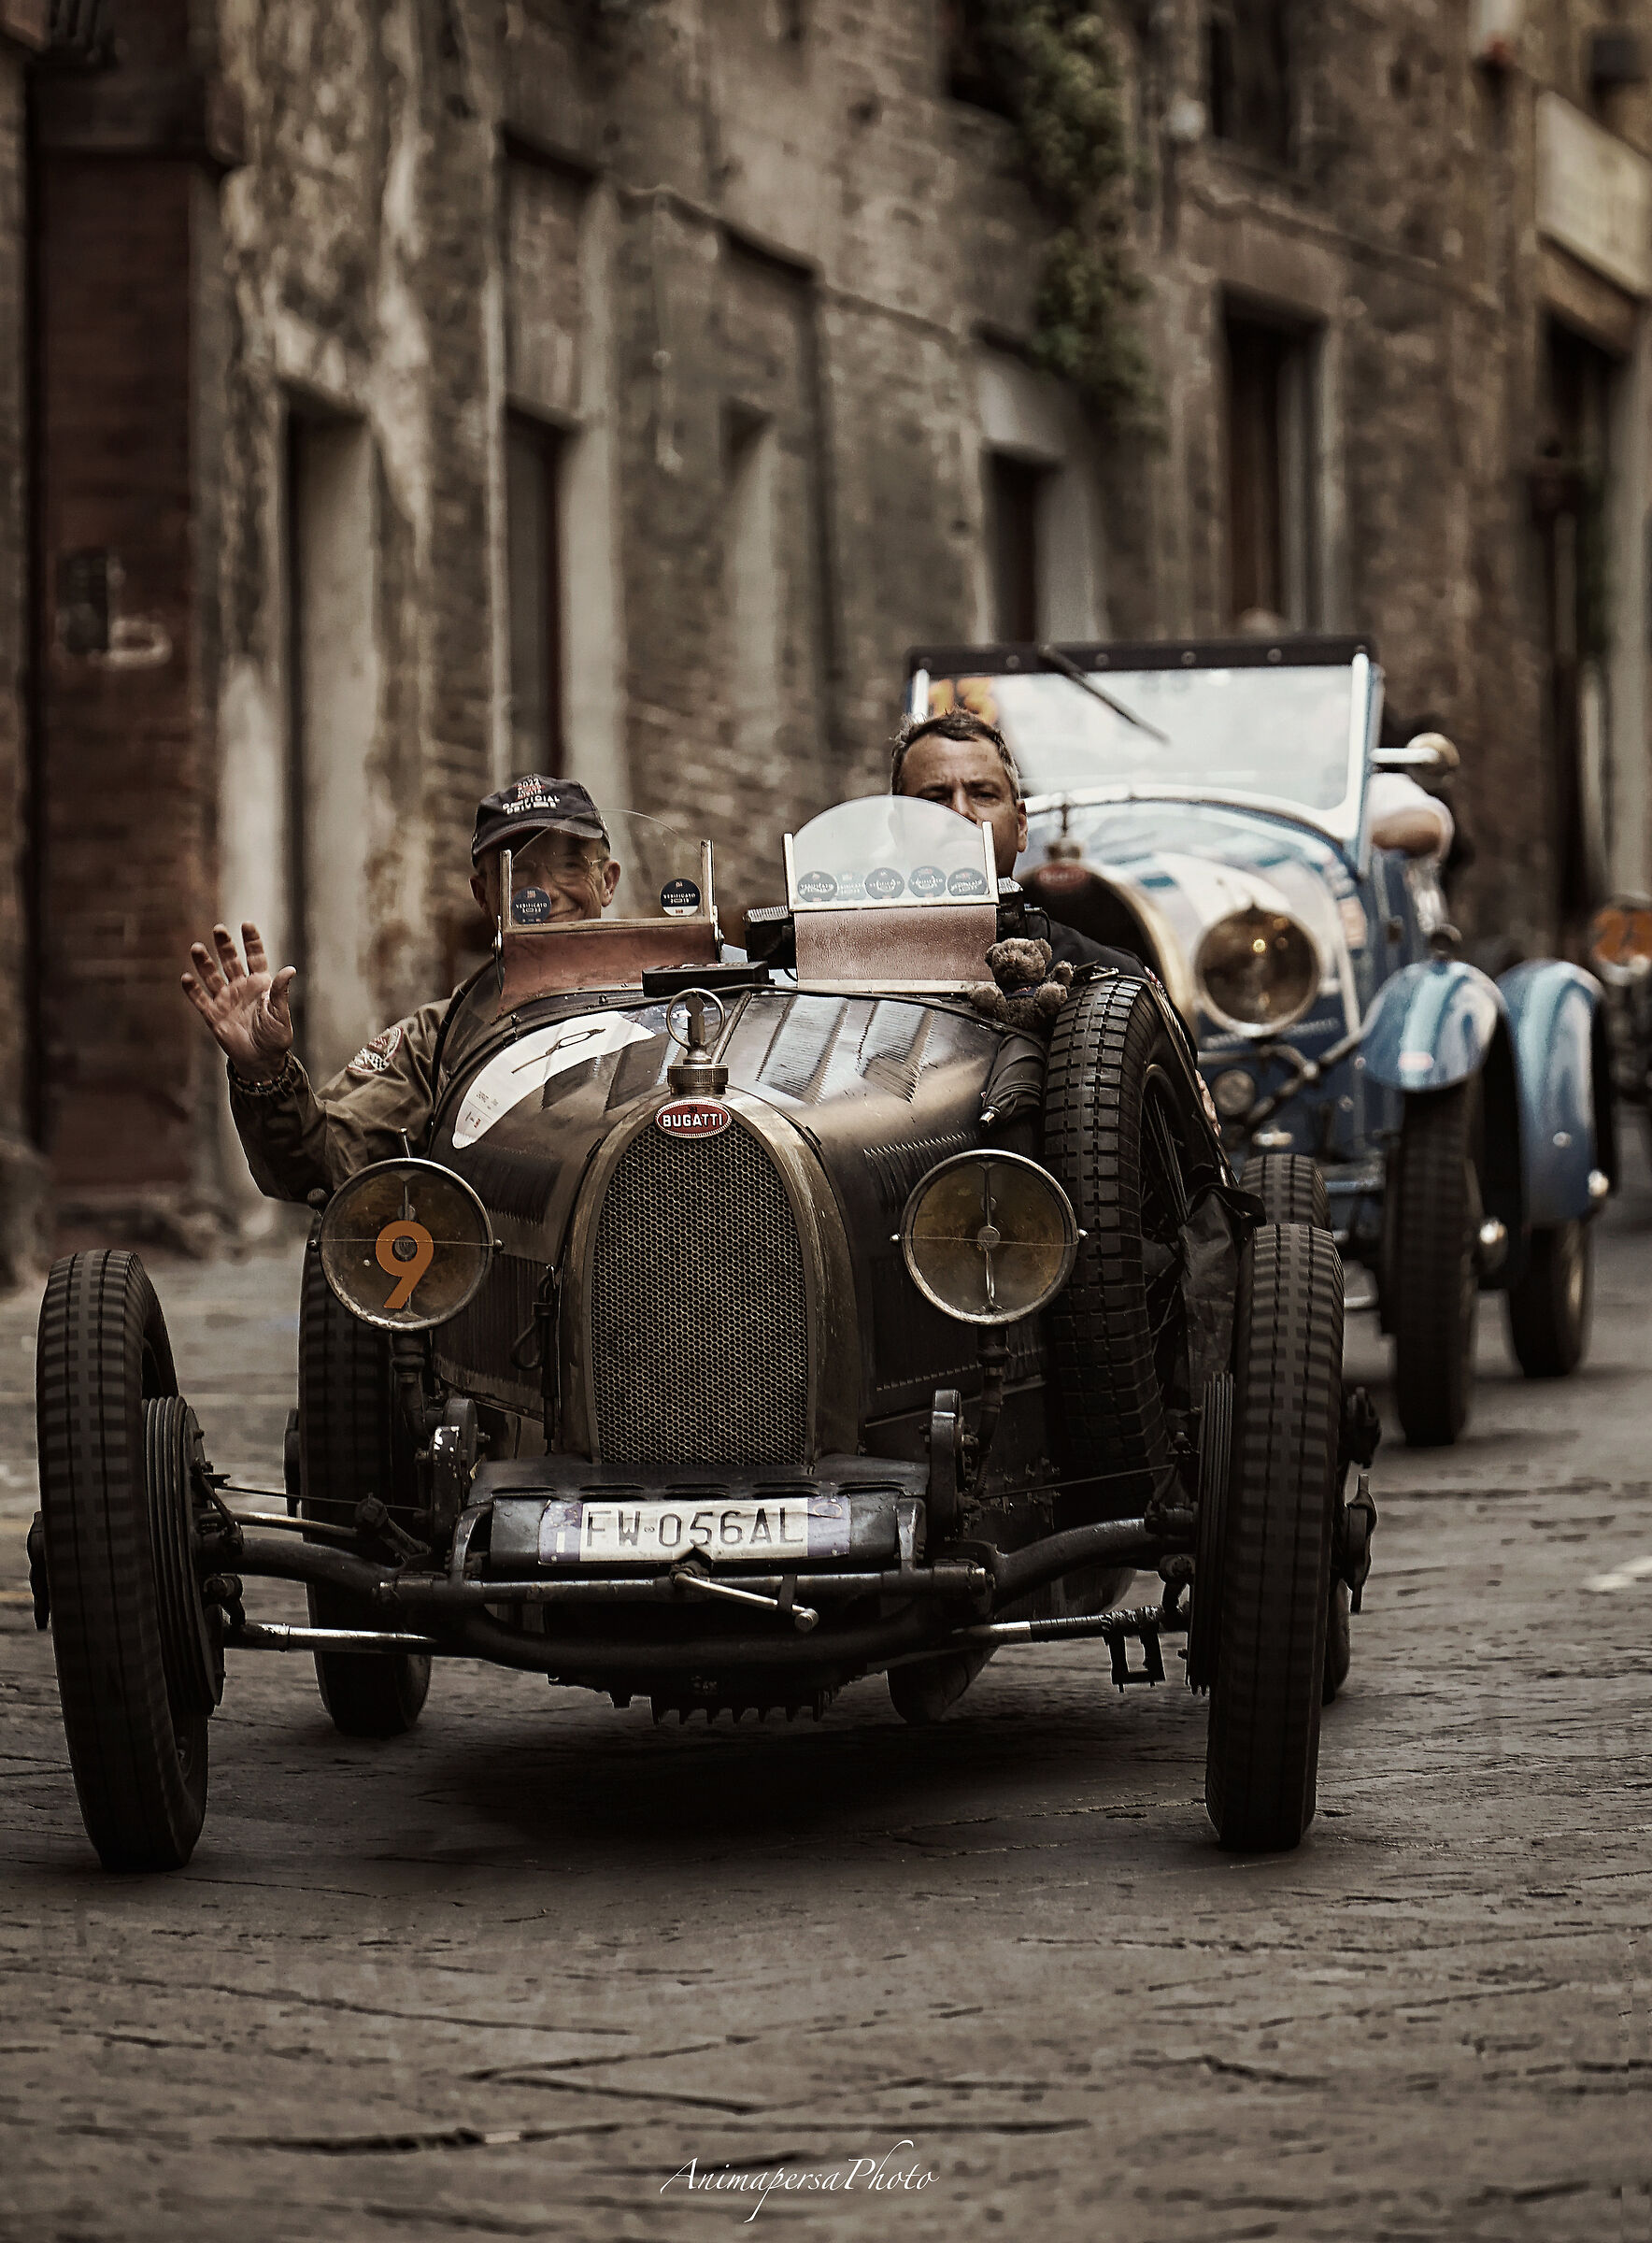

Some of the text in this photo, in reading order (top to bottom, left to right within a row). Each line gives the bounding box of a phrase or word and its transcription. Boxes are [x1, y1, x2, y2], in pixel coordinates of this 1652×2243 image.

[662, 1113, 723, 1127] BUGATTI
[375, 1220, 434, 1308] 9
[587, 1509, 641, 1547] FW
[659, 1507, 804, 1547] 056AL
